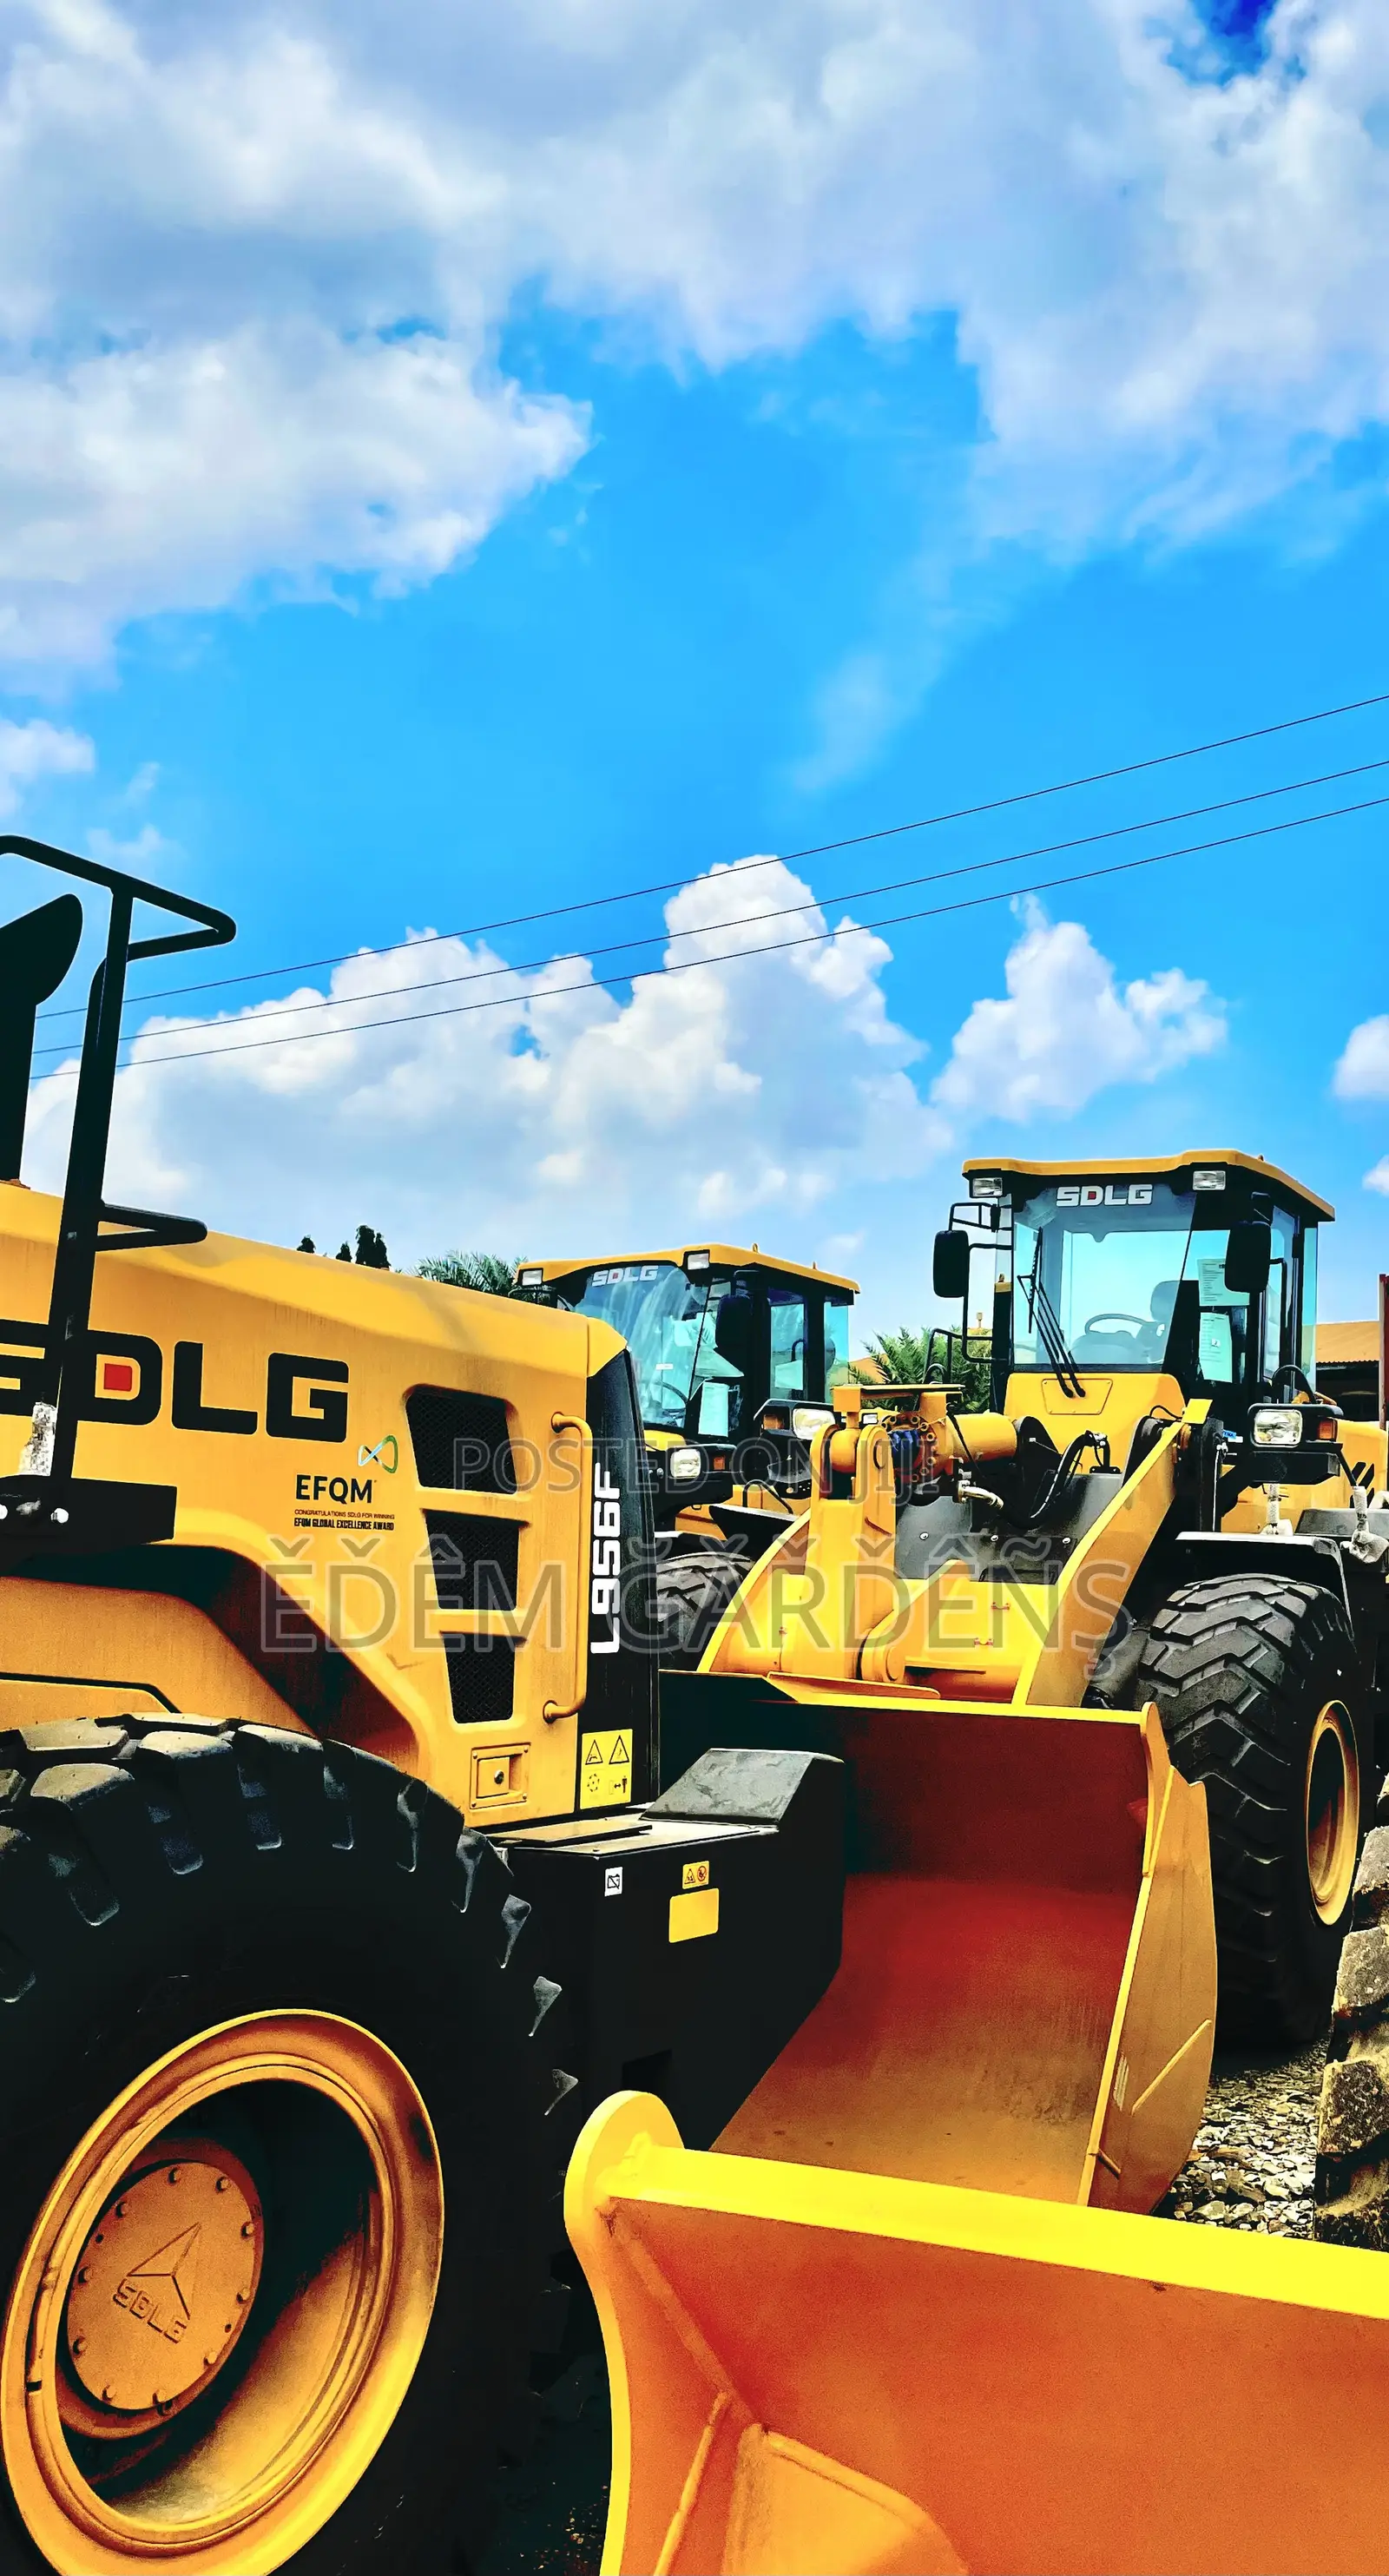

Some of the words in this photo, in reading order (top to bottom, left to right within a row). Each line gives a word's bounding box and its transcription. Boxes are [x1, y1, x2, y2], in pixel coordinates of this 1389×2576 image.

[1057, 1184, 1153, 1207] SDLG
[592, 1265, 659, 1287] SDLG
[295, 1474, 373, 1505] EFQM
[293, 1517, 312, 1527] EFQM
[312, 1519, 335, 1528] GLOBAL
[337, 1519, 372, 1530] EXCELLENCE
[372, 1521, 395, 1532] AWARD
[294, 1509, 346, 1518] CONGRATULATIONS
[590, 1462, 621, 1654] L956F
[113, 2277, 188, 2344] SDLG
